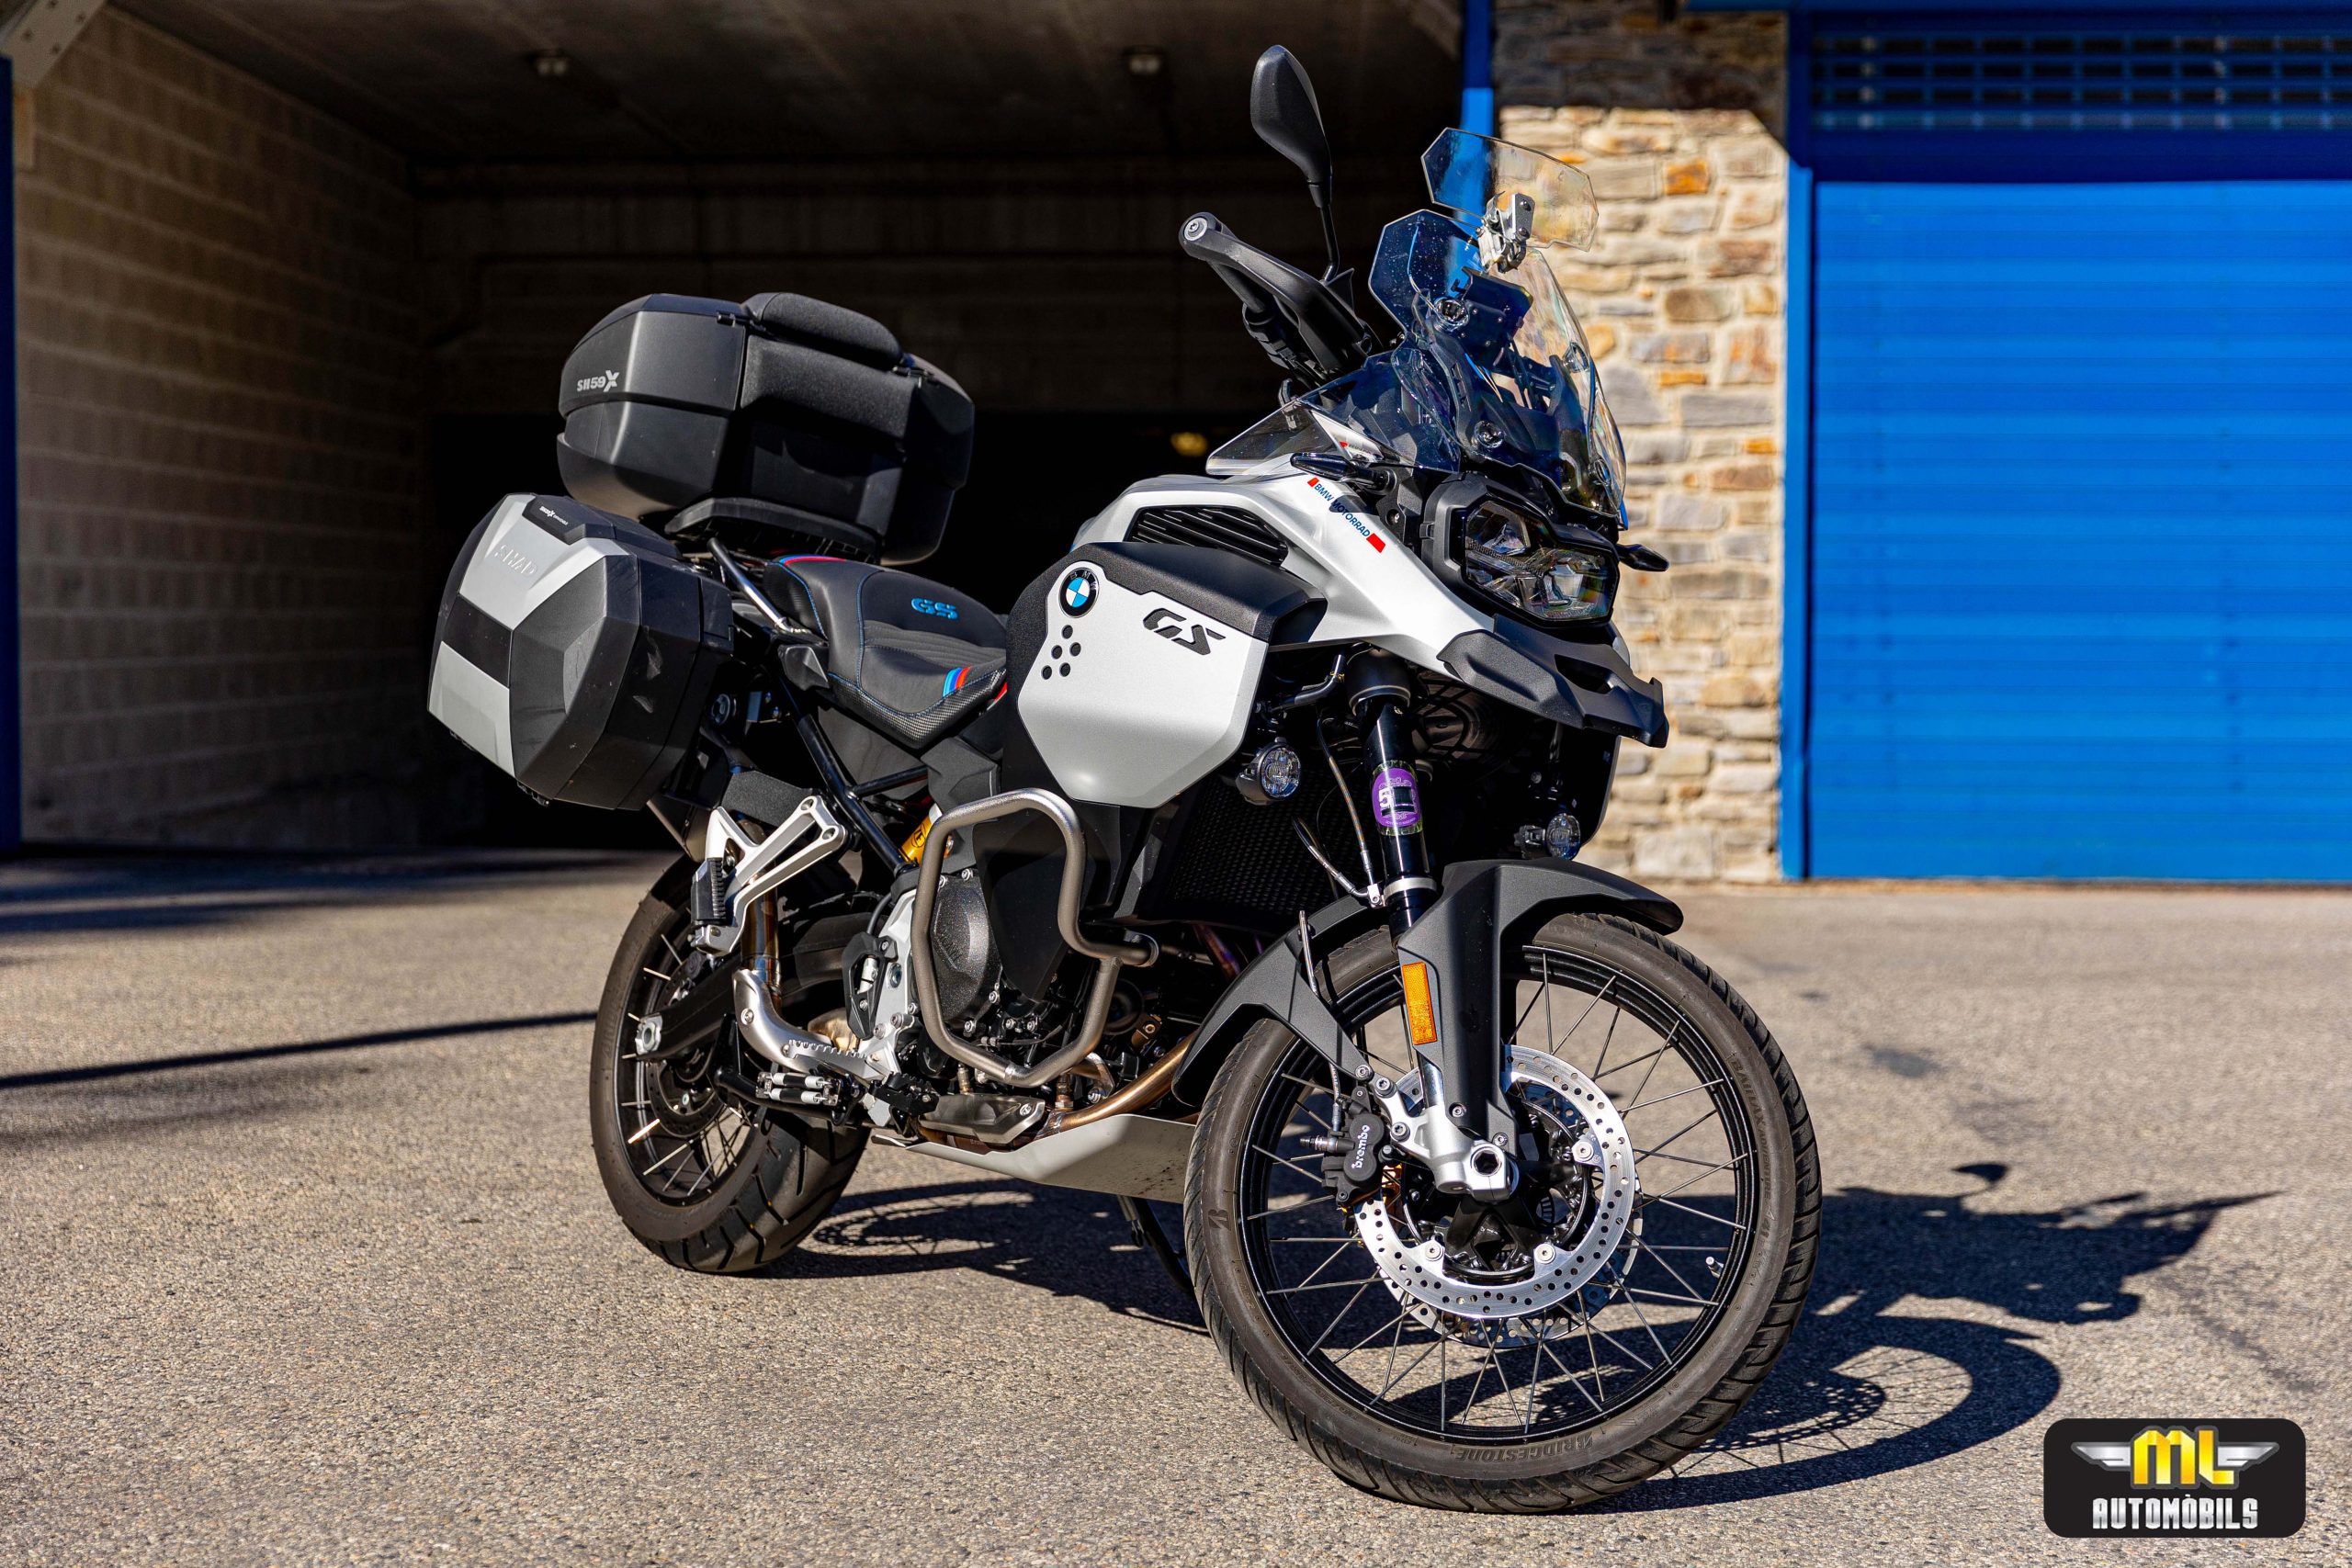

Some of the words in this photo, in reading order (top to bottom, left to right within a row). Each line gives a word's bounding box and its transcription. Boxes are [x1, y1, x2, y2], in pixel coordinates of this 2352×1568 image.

[576, 369, 620, 393] SH59X
[1314, 483, 1335, 502] BMW
[1331, 499, 1371, 537] MOTORRAD
[1069, 570, 1098, 591] BMW
[910, 597, 958, 620] GS
[1142, 607, 1227, 656] GS
[1351, 1124, 1371, 1168] brembo
